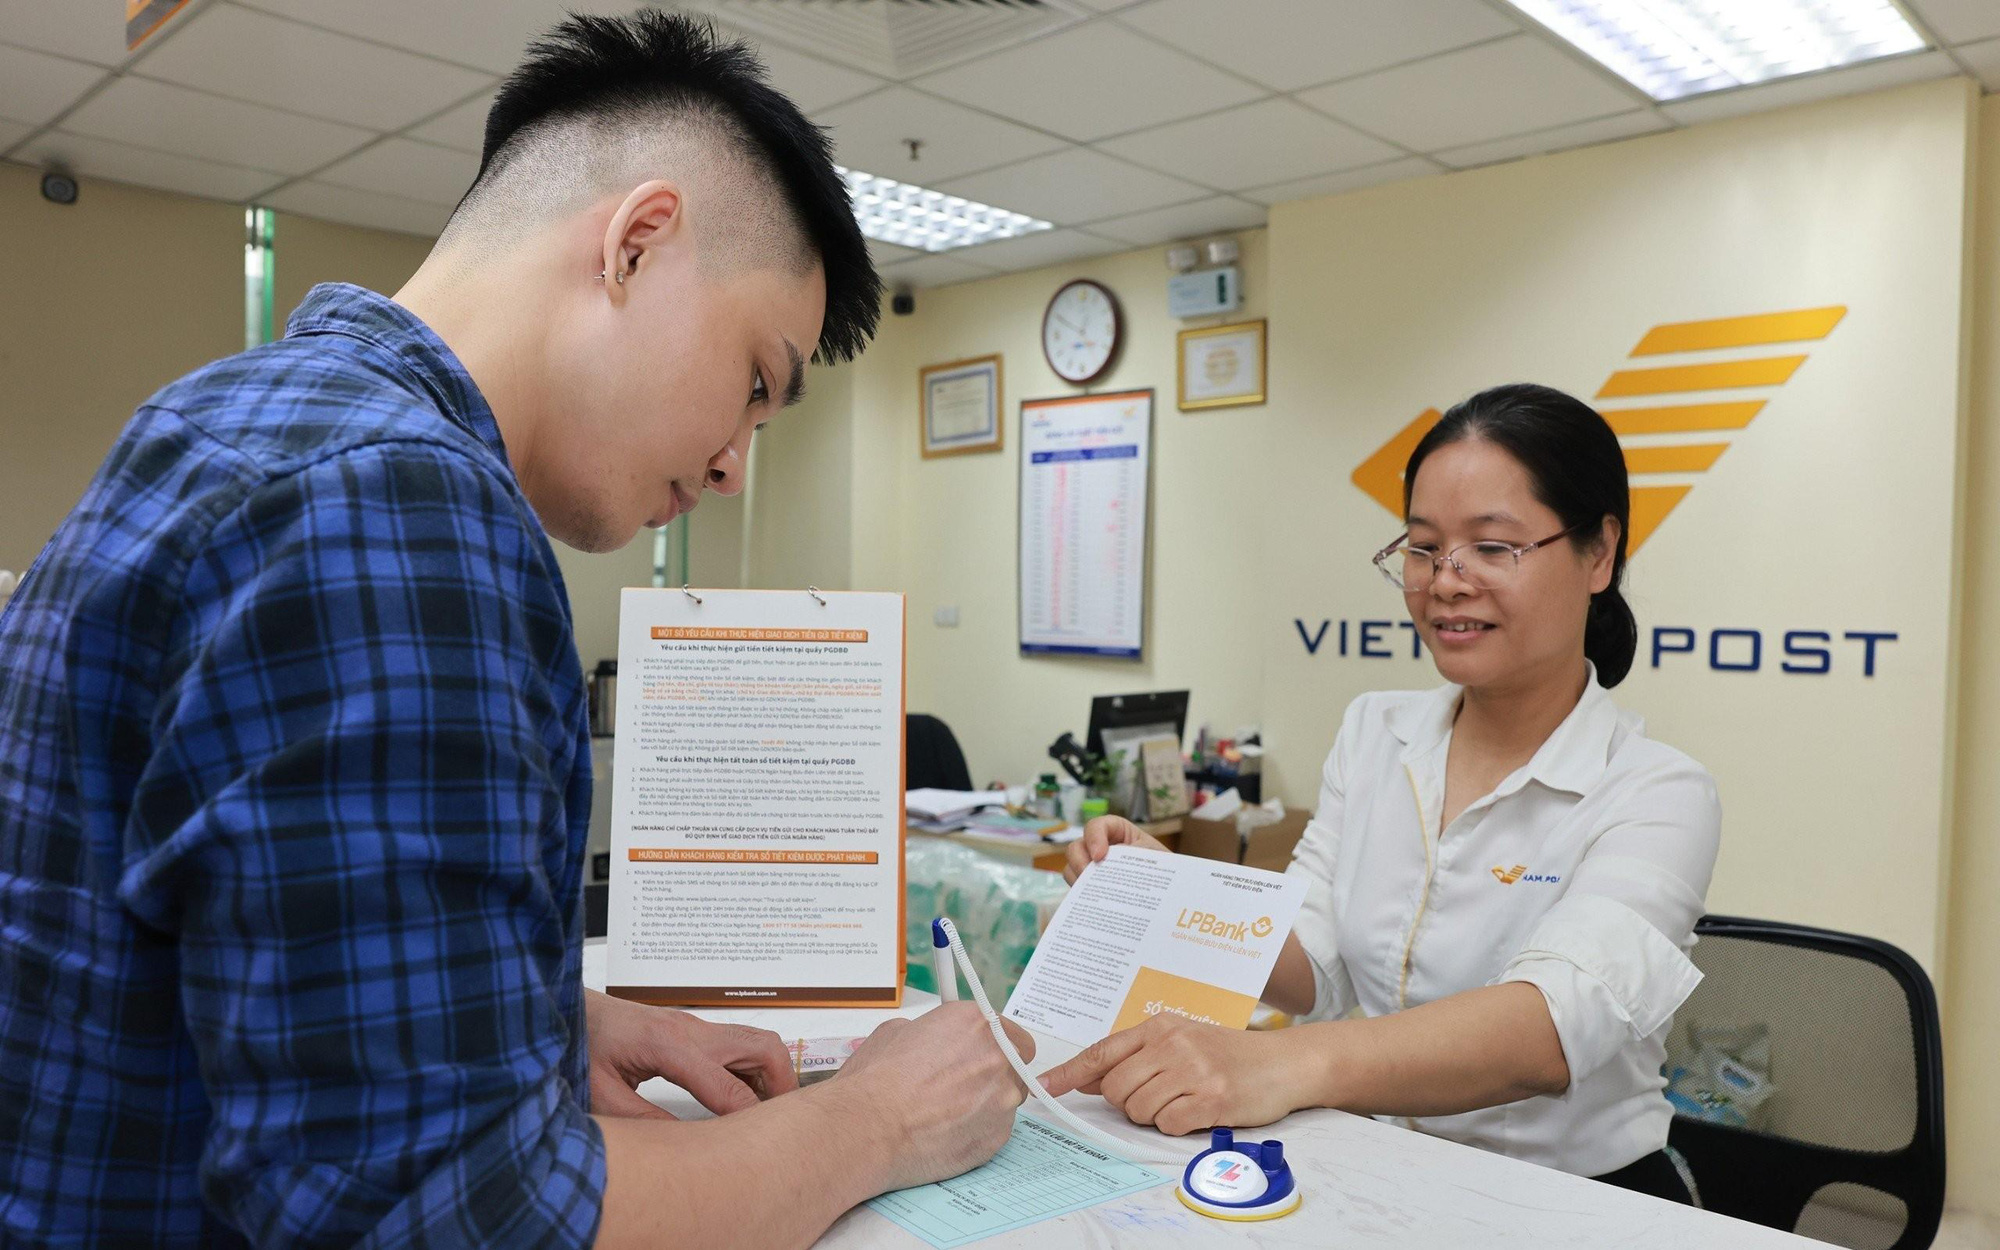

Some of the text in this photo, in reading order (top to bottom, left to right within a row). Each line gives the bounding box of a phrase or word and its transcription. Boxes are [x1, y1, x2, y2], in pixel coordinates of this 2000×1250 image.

[1295, 619, 1898, 676] VIET POST
[1177, 908, 1249, 942] LPBank
